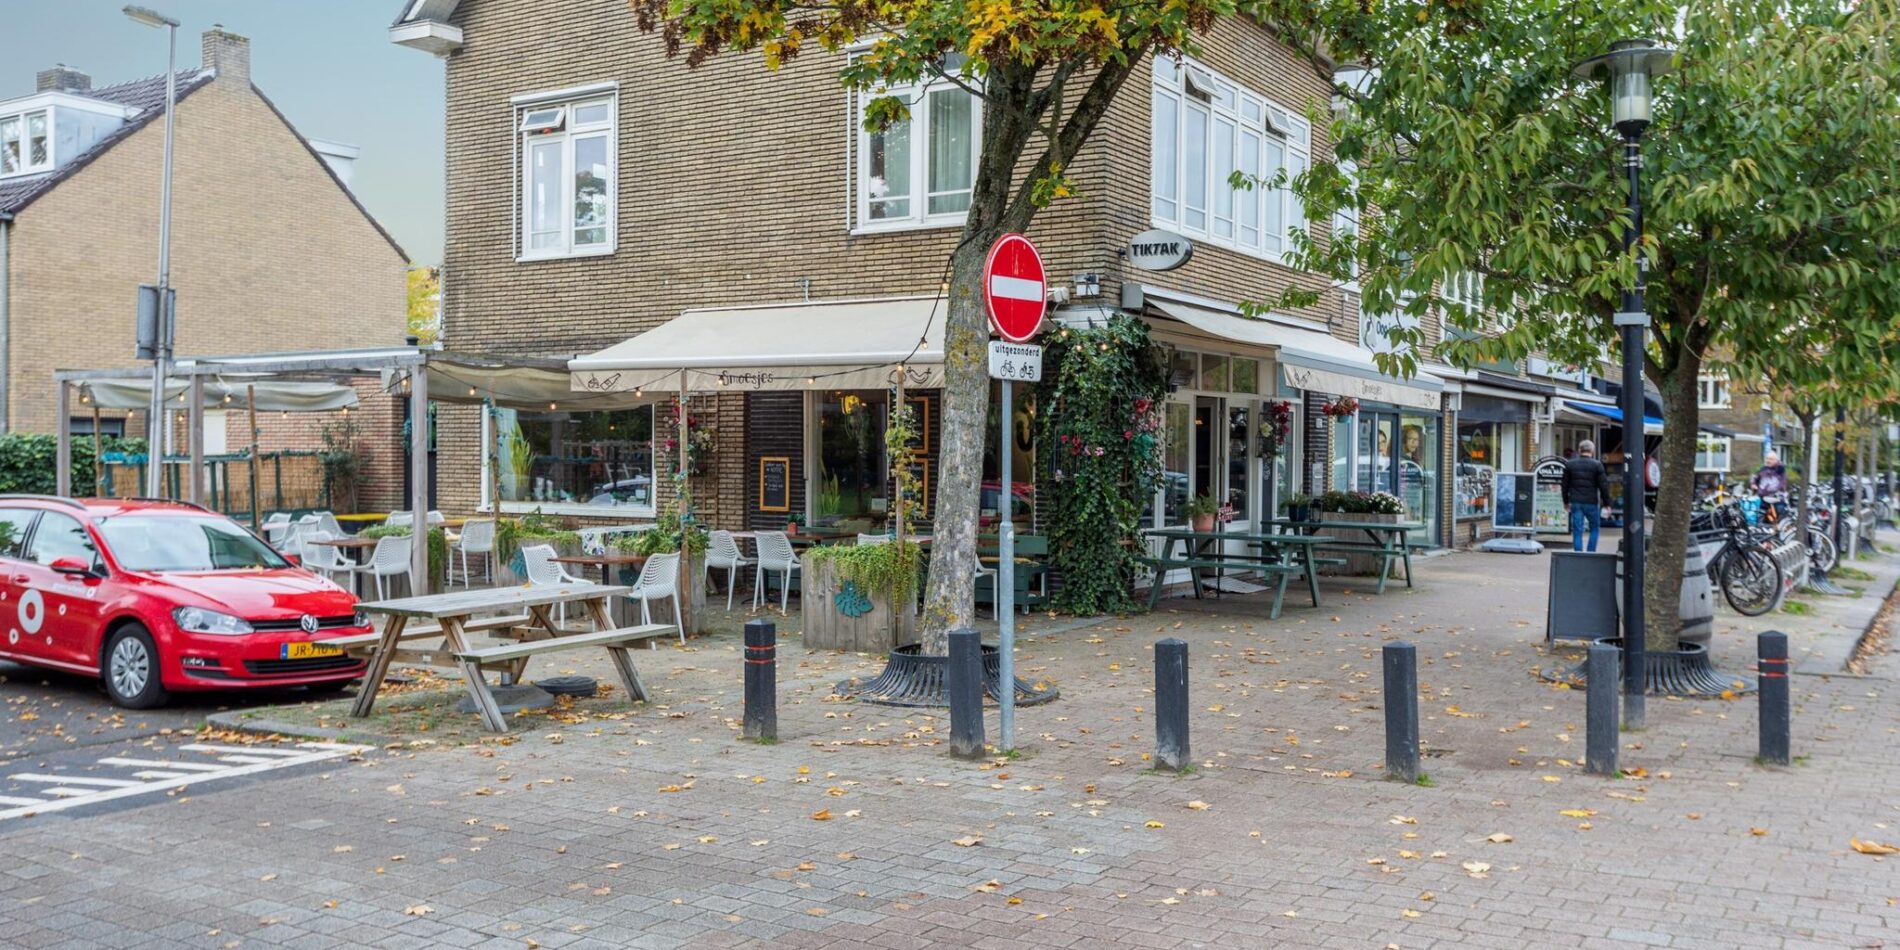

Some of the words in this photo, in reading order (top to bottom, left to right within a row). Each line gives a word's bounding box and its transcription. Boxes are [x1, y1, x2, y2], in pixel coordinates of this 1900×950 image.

[1132, 242, 1179, 256] TIKTAK
[995, 345, 1040, 357] uitgezonderd
[722, 370, 774, 389] Smoesjes
